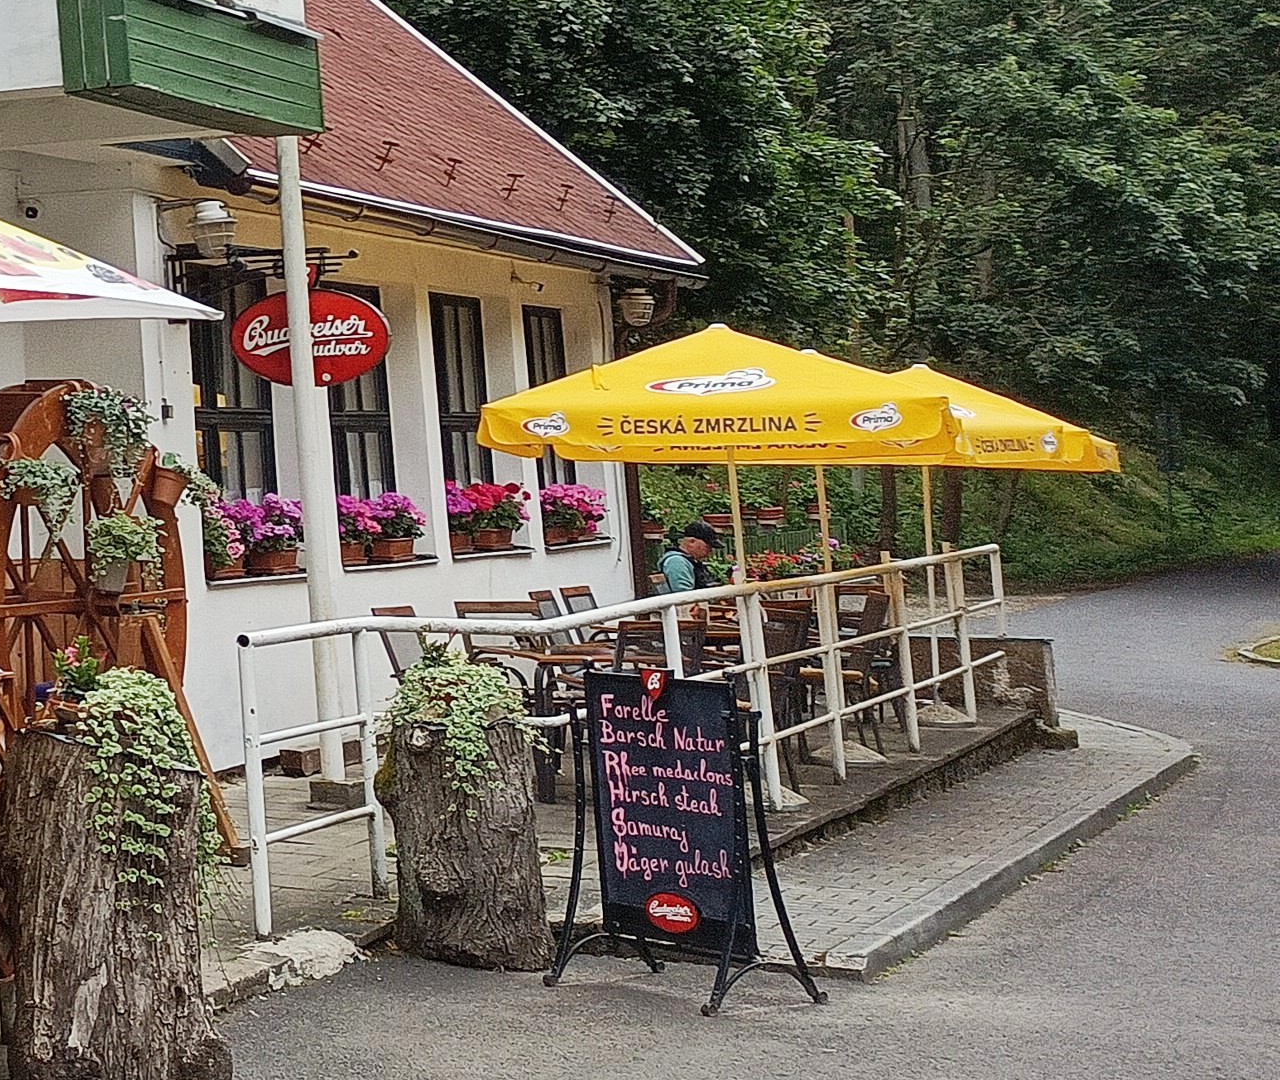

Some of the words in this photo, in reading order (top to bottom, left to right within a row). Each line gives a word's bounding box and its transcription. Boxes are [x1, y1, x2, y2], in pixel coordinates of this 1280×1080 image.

[676, 380, 753, 390] Prima
[533, 421, 562, 432] Prima
[620, 415, 687, 435] ČESKÁ
[693, 416, 797, 434] ZMRZLINA
[862, 415, 893, 424] Prima
[600, 694, 669, 722] Forelle
[673, 726, 725, 753] Natur
[608, 780, 669, 808] Hirsch
[675, 849, 732, 888] gulash
